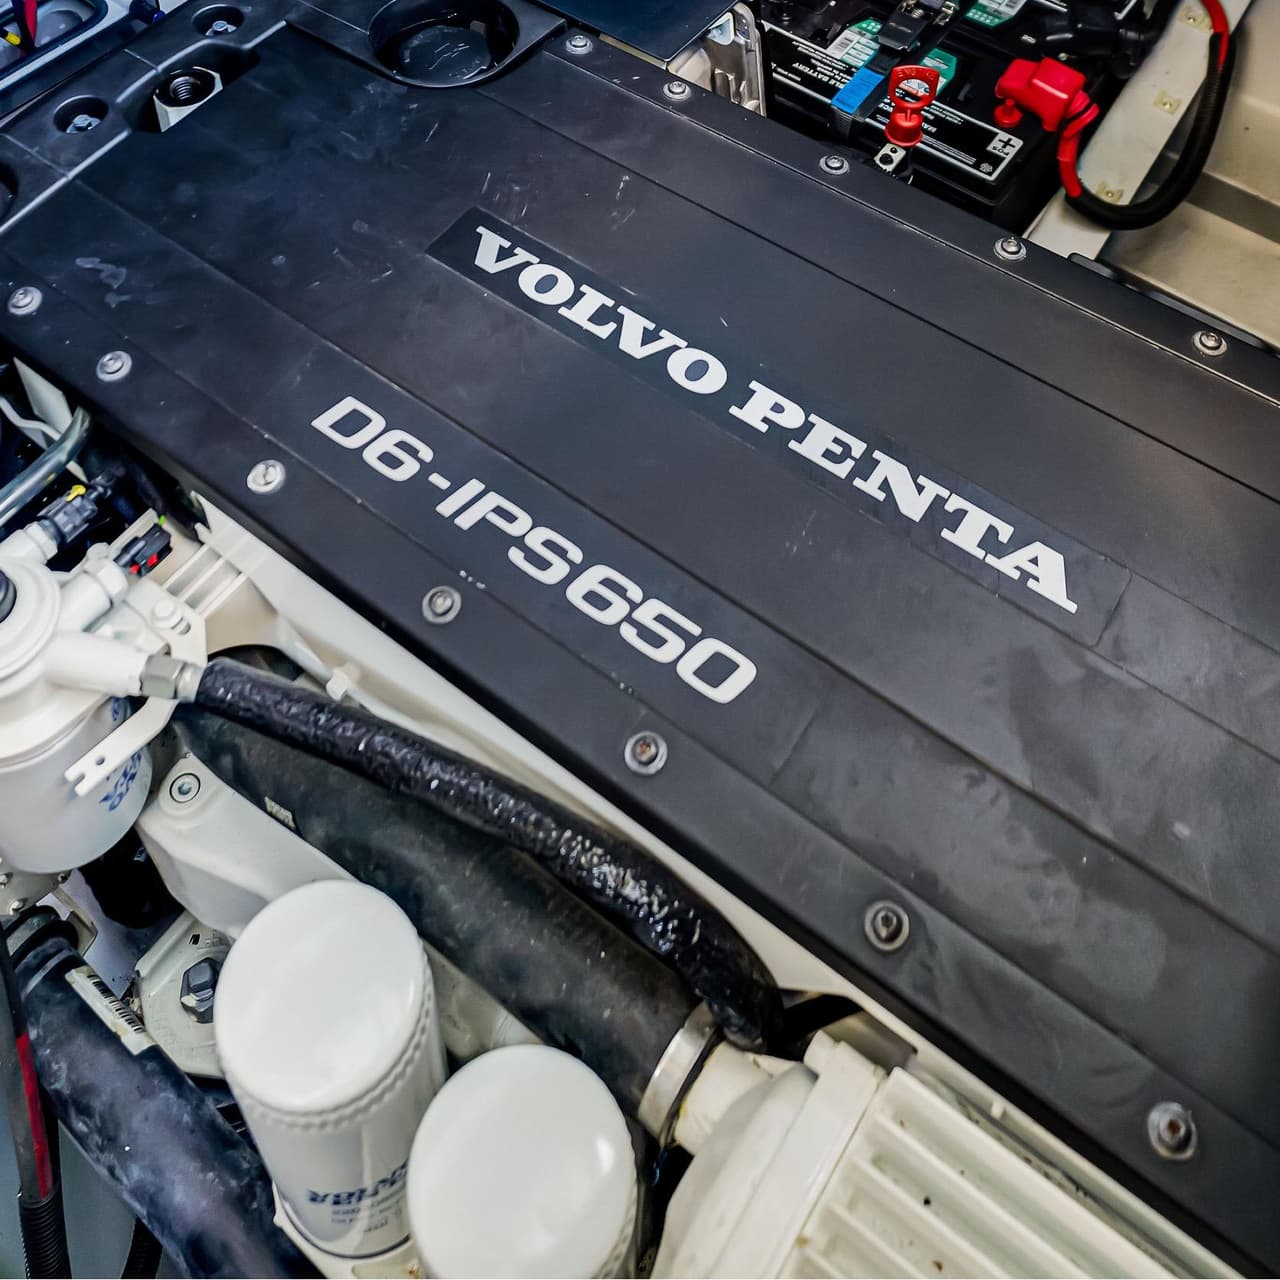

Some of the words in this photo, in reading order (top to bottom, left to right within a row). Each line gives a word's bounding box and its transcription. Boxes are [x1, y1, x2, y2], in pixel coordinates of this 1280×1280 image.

[792, 62, 830, 82] BATTERY
[310, 395, 758, 705] D6-IPS650
[474, 225, 728, 395] VOLVO
[728, 379, 1079, 615] PENTA
